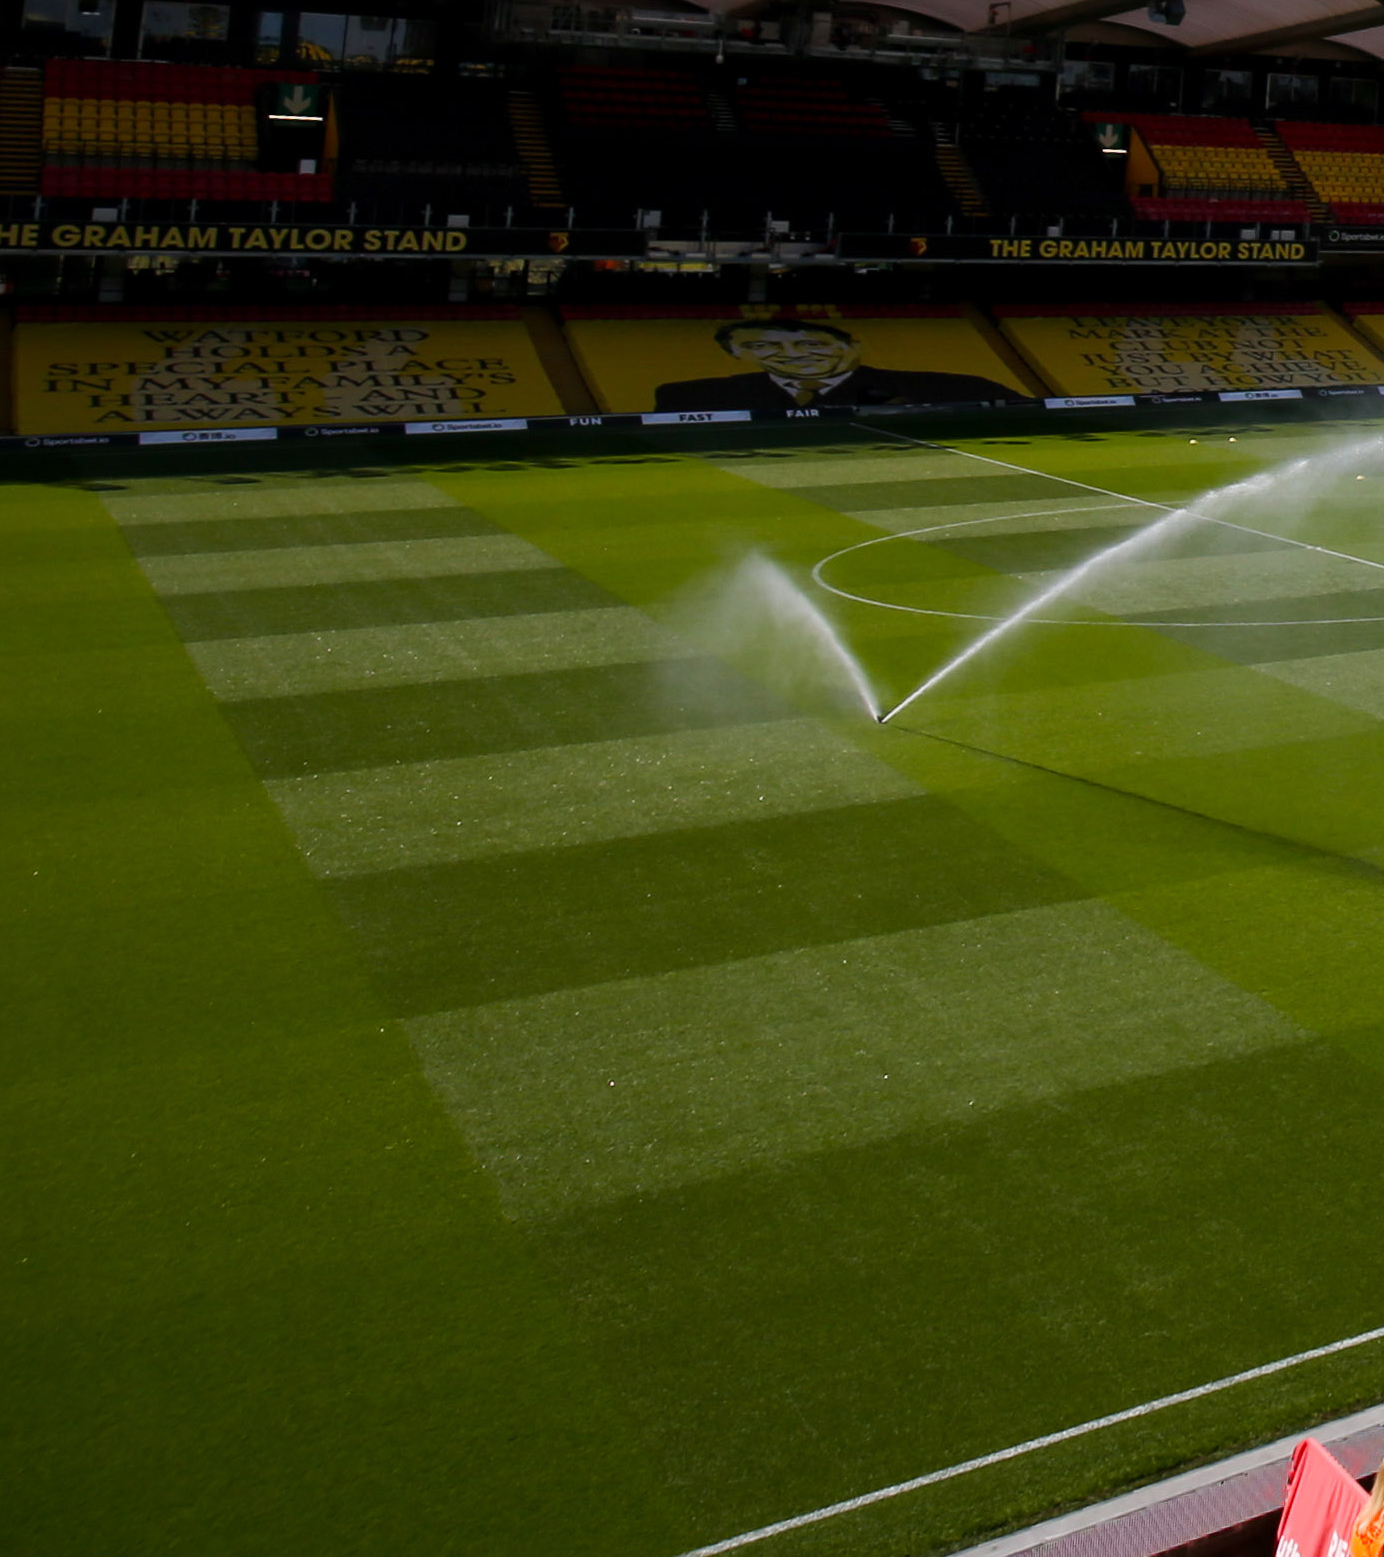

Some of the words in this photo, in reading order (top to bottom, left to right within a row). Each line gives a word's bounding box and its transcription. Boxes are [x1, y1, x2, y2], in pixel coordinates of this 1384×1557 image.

[51, 224, 218, 250] GRAHAM
[228, 227, 355, 252] TAYLOR
[363, 229, 468, 253] STAND
[989, 238, 1032, 259] THE
[1038, 239, 1146, 259] GRAHAM
[1151, 240, 1231, 260] TAYLOR
[1236, 242, 1306, 261] STAND
[140, 329, 429, 344] WATFORD
[1069, 328, 1191, 339] MARK
[165, 345, 368, 360] HOLDS
[387, 344, 418, 356] A
[1109, 341, 1218, 351] CLUB
[1081, 352, 1174, 366] JUST
[1189, 351, 1234, 363] BY
[1242, 349, 1354, 361] WHAT
[48, 360, 311, 376] SPECIAL
[329, 358, 509, 373] PLACE
[1099, 364, 1186, 376] YOU
[1201, 360, 1367, 374] ACHIEVE
[44, 378, 114, 392] IN
[139, 376, 236, 391] MY
[257, 372, 517, 390] FAMILY'S
[1104, 375, 1190, 388] BUT
[1204, 373, 1295, 386] HOW
[90, 391, 306, 408] HEART
[359, 387, 487, 403] AND
[96, 405, 342, 423] ALWAYS
[352, 402, 507, 416] WILL
[569, 417, 603, 427] FUN
[678, 412, 715, 422] FAST
[785, 408, 822, 419] FAIR
